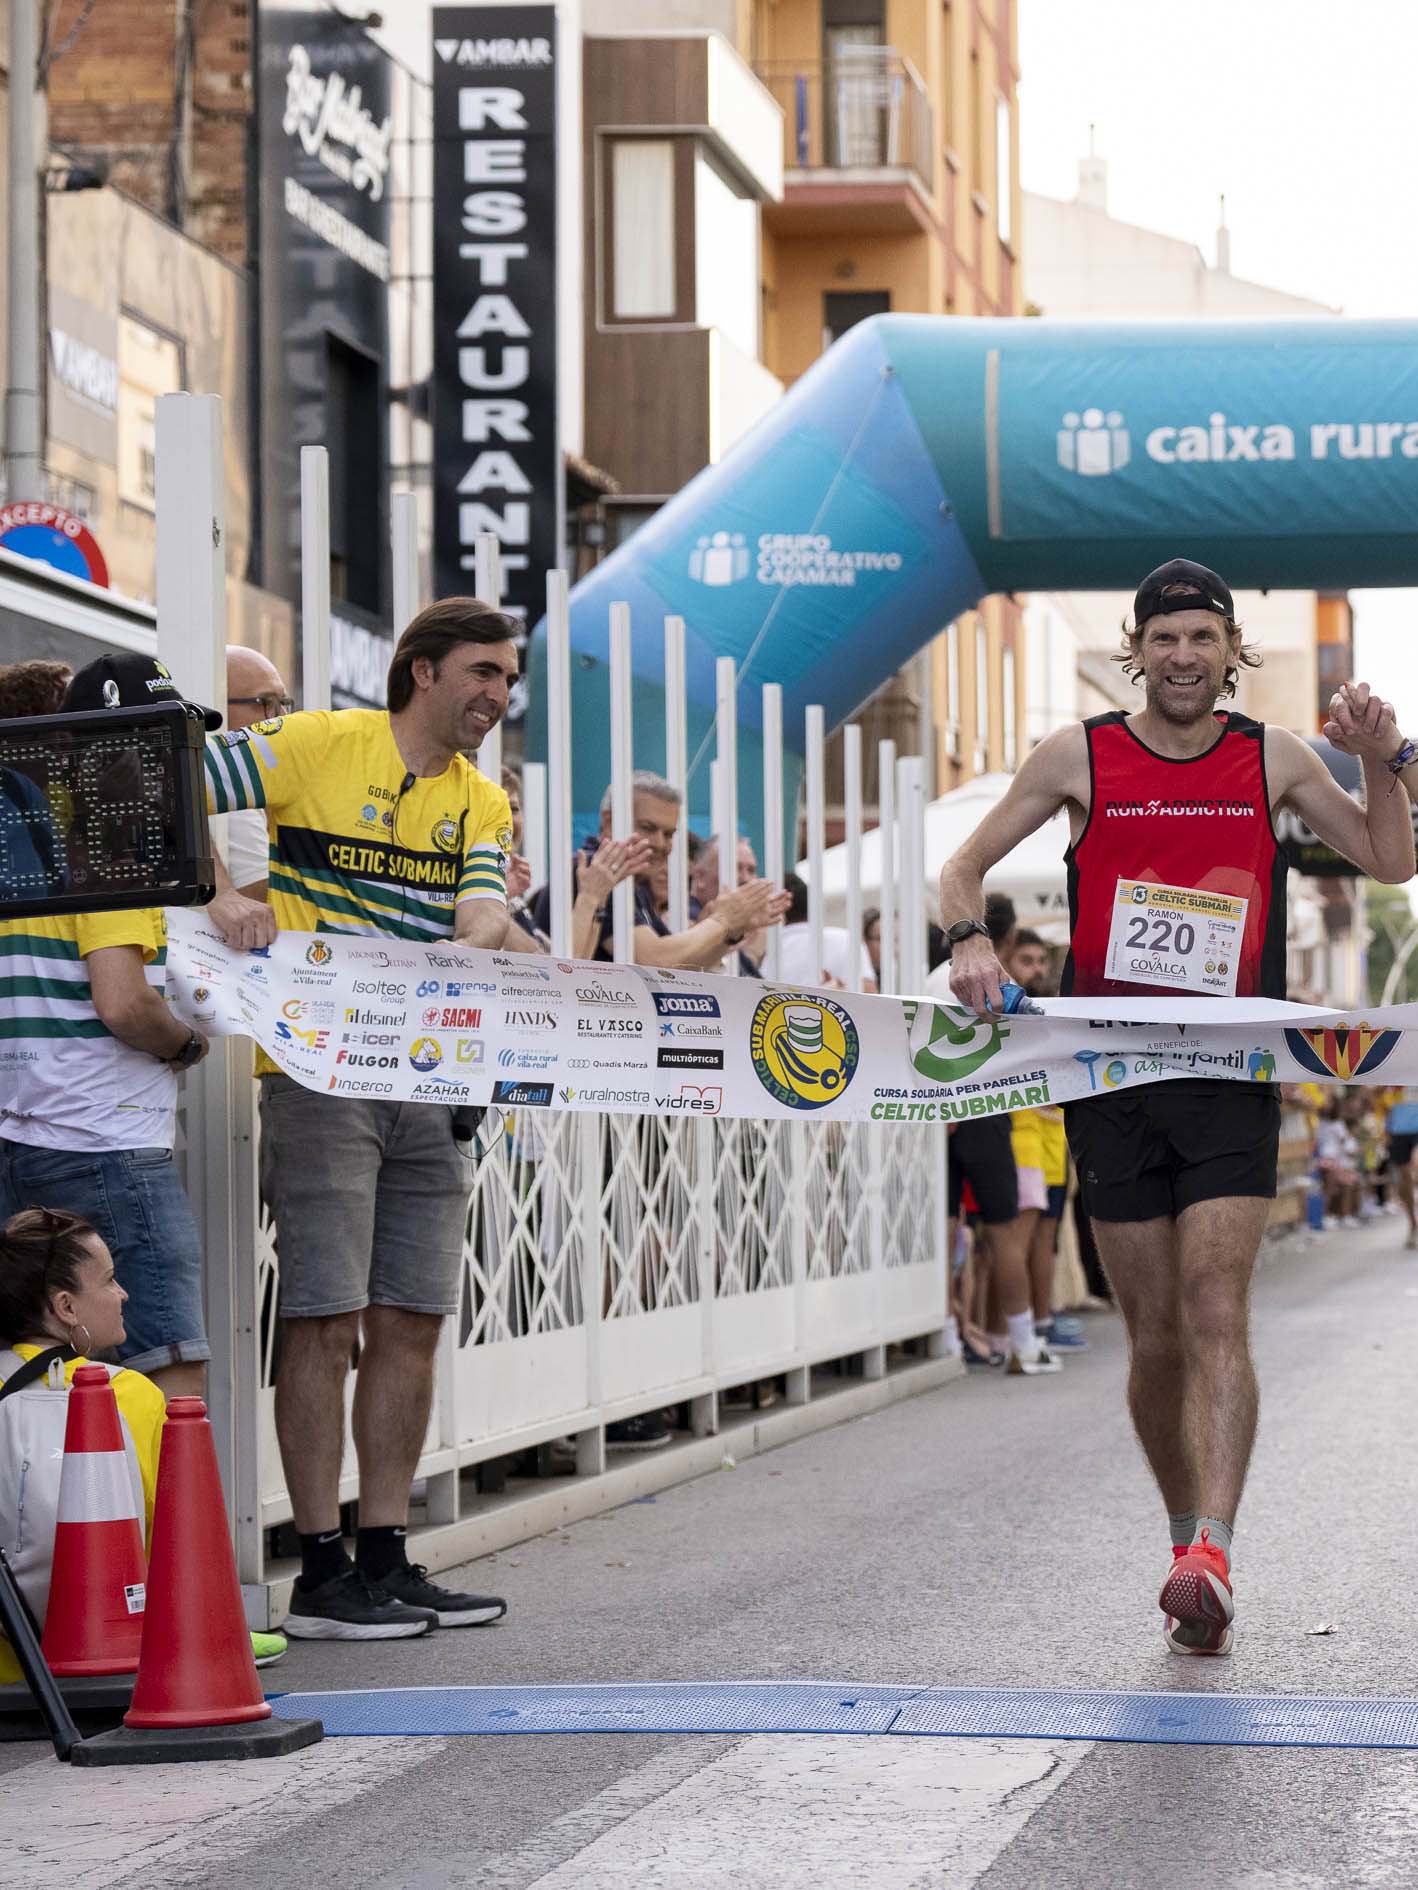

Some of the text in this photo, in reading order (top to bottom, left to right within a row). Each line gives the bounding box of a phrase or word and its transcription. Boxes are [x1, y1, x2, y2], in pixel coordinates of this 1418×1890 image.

[457, 38, 552, 65] AMBAR
[457, 86, 531, 648] RESTAURANT
[1146, 412, 1294, 464] caixa
[0, 503, 82, 538] XCEPTO
[758, 534, 830, 553] GRUPO
[756, 550, 902, 571] COOPERATIVO
[757, 567, 855, 587] CAJAMAR
[1106, 801, 1254, 817] RUN ADDICTION
[328, 844, 384, 875] CELTIC
[428, 891, 454, 902] VILA-RE
[1152, 893, 1186, 905] CELTIC
[1148, 908, 1184, 920] RAMON
[1125, 917, 1195, 955] 220
[292, 967, 338, 978] Ajuntament
[1130, 956, 1187, 976] COVALCA
[352, 980, 407, 996] Isoltec
[416, 980, 440, 998] 60
[576, 984, 634, 1003] COVALCA
[381, 996, 405, 1005] Group
[362, 1009, 406, 1027] disinel
[442, 1008, 482, 1029] SACMI
[577, 1019, 643, 1032] EL VASCO
[577, 1031, 613, 1039] RESTAURANTE
[677, 1023, 723, 1036] CaixaBank
[751, 1061, 799, 1107] CELTIC
[776, 993, 853, 1031] VILA-REAL
[1154, 1041, 1189, 1050] BENEFICI
[336, 1050, 399, 1069] FULGOR
[517, 1061, 548, 1069] vila-real
[518, 1054, 558, 1062] caixa rural
[593, 1061, 622, 1069] Quadis
[338, 1079, 393, 1093] incerco
[413, 1084, 470, 1096] AZAHAR
[874, 1070, 1047, 1098] CURSA SOLIDÀRIA PER PARELLES
[579, 1087, 650, 1103] ruralnostra
[655, 1094, 715, 1110] vidres
[871, 1079, 1050, 1121] CELTIC SUBMARÍ
